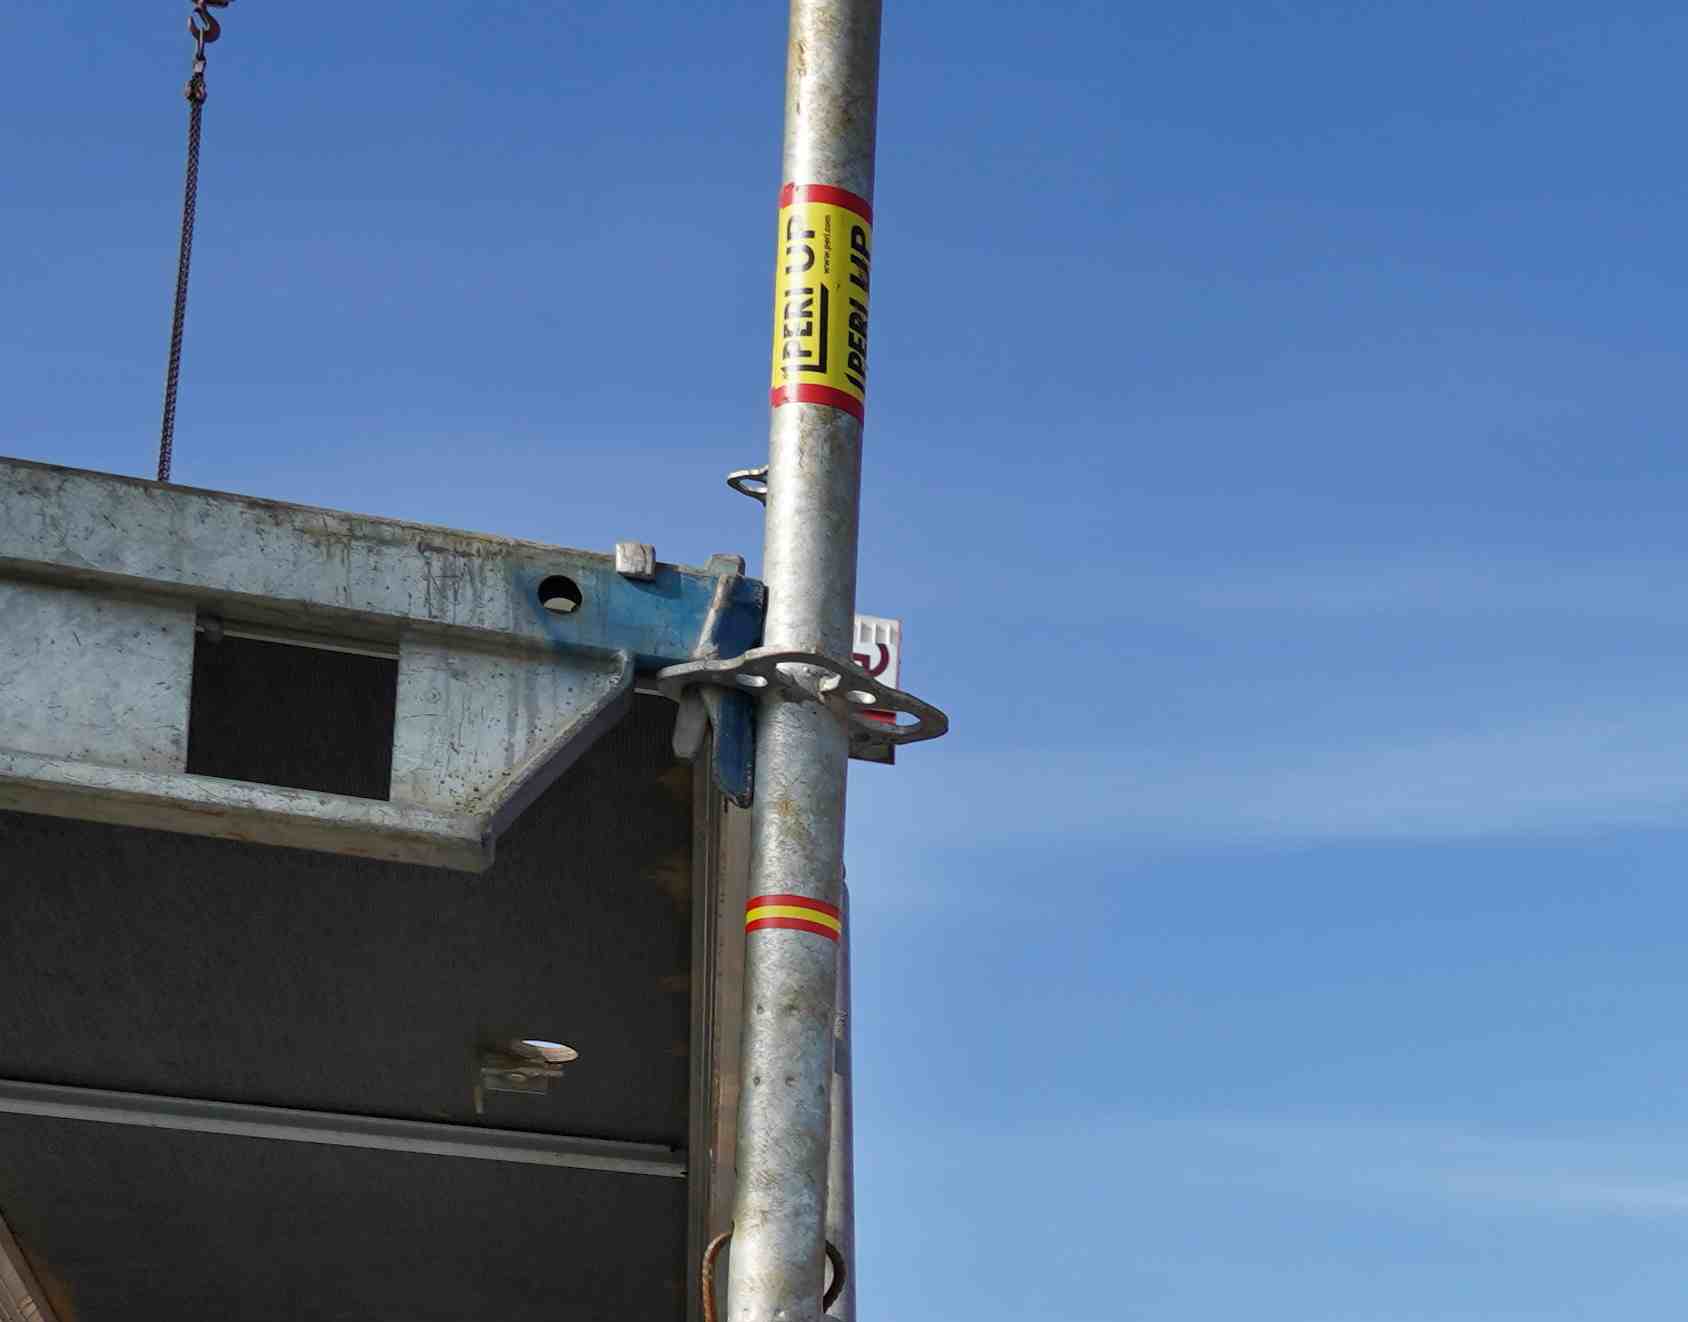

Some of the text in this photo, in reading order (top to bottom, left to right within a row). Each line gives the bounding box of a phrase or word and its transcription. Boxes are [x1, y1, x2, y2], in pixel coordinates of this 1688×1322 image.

[783, 214, 816, 359] PERI UP
[846, 224, 873, 381] PERI UP
